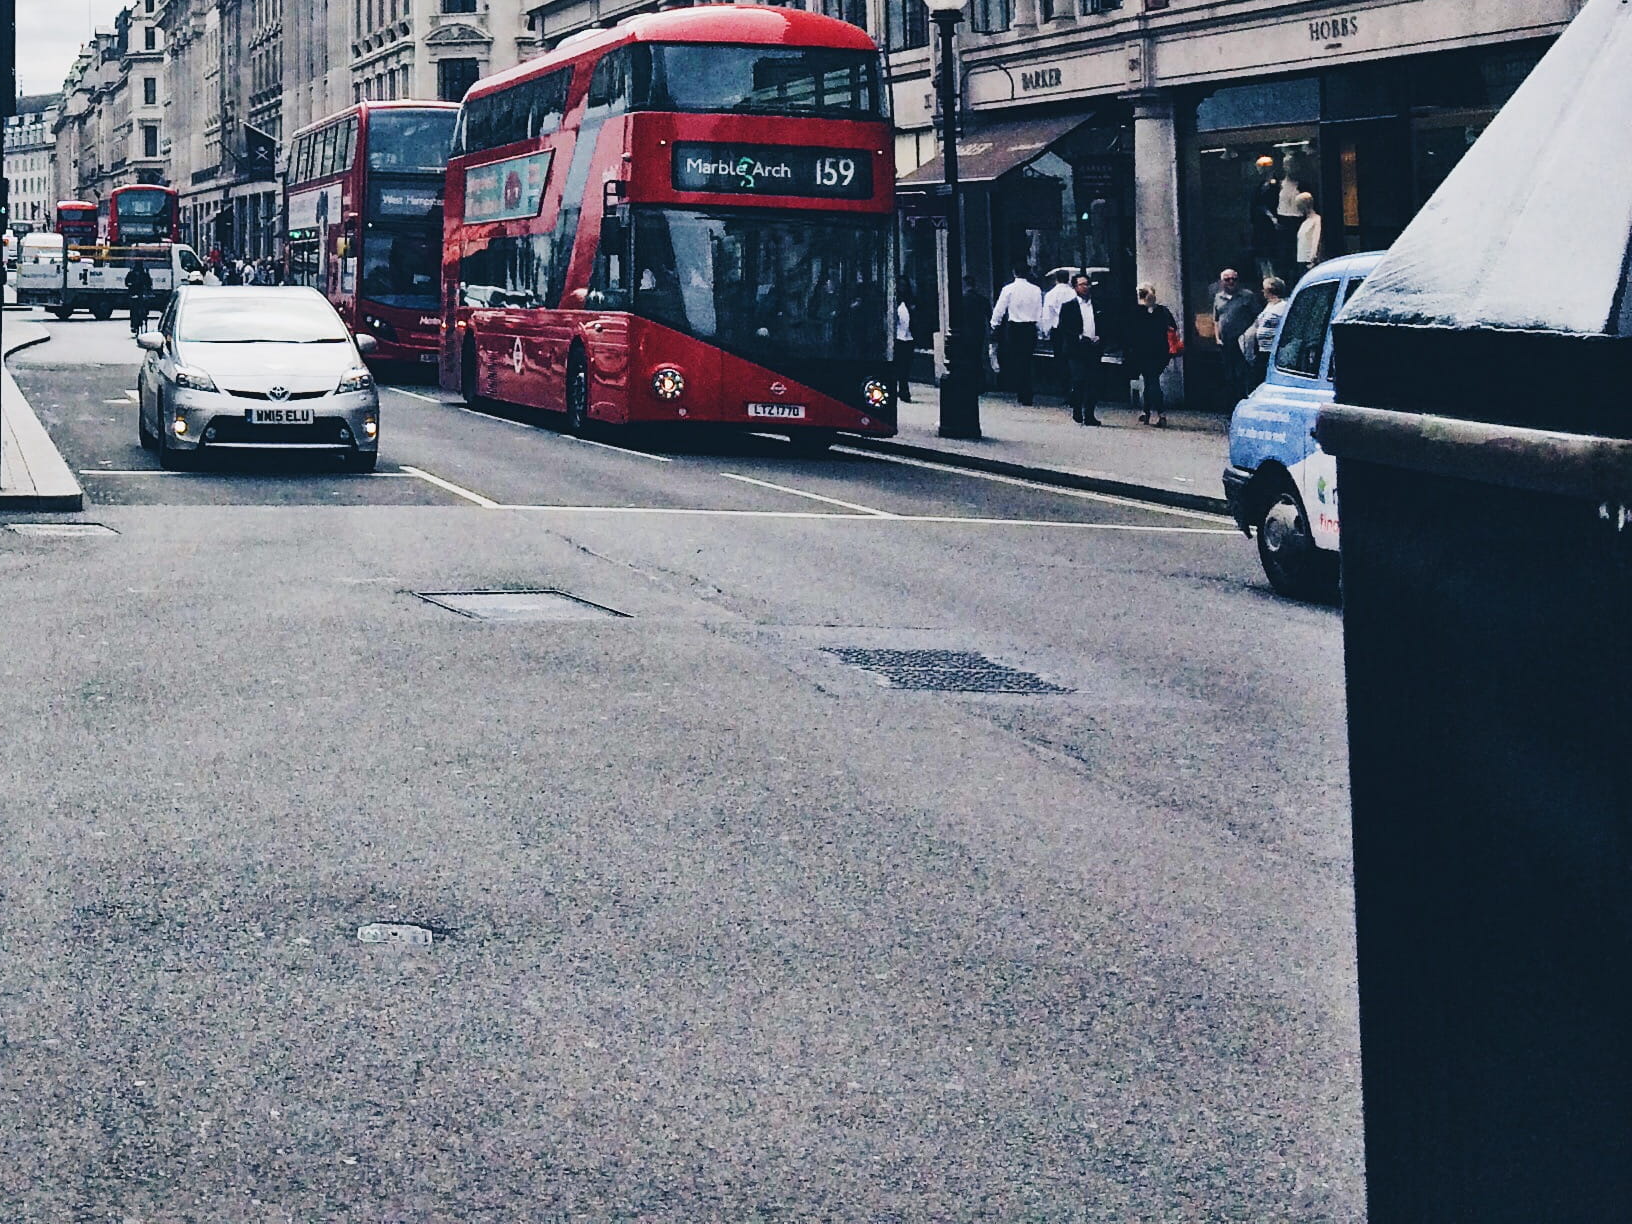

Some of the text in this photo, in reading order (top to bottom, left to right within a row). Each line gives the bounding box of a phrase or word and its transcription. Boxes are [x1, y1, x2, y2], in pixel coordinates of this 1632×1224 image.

[1309, 16, 1358, 41] HOBBS
[1021, 67, 1062, 91] BARKER
[686, 158, 855, 186] Marble Arch 159
[286, 409, 309, 422] ELU
